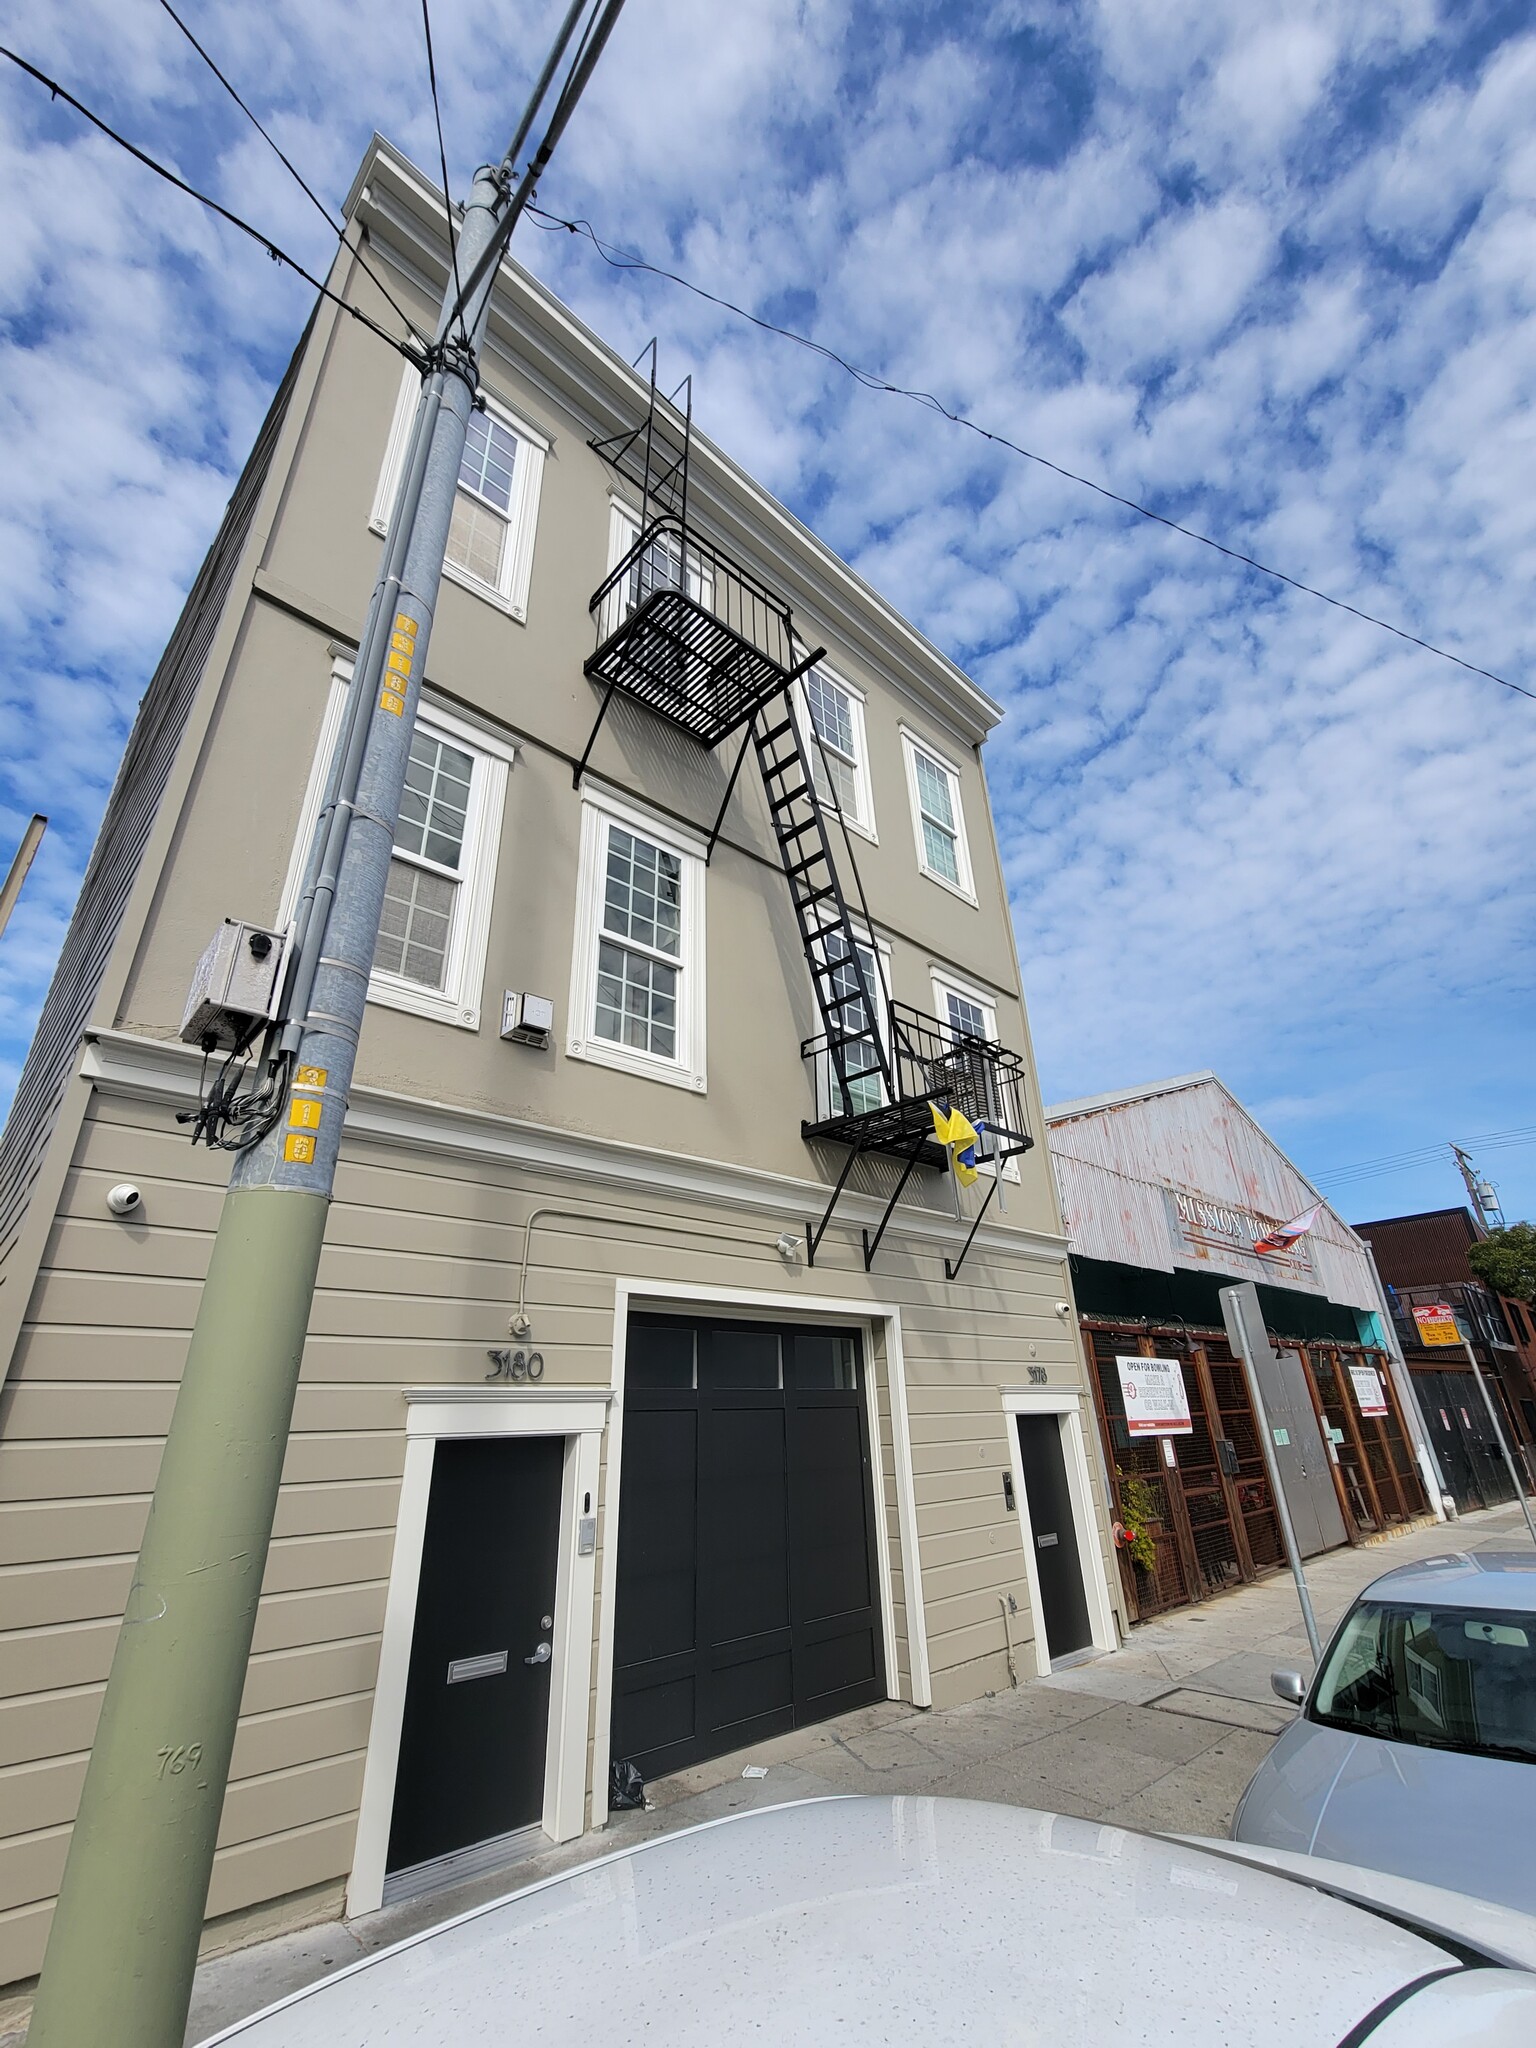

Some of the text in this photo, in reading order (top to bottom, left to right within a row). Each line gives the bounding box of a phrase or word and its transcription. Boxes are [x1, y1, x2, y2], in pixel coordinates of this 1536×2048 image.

[1175, 1193, 1245, 1240] MISSION
[1428, 1315, 1452, 1323] STOPPING
[485, 1350, 544, 1380] 3180
[1127, 1362, 1170, 1372] OPEN FOR BOWLING
[157, 1742, 203, 1781] 769
